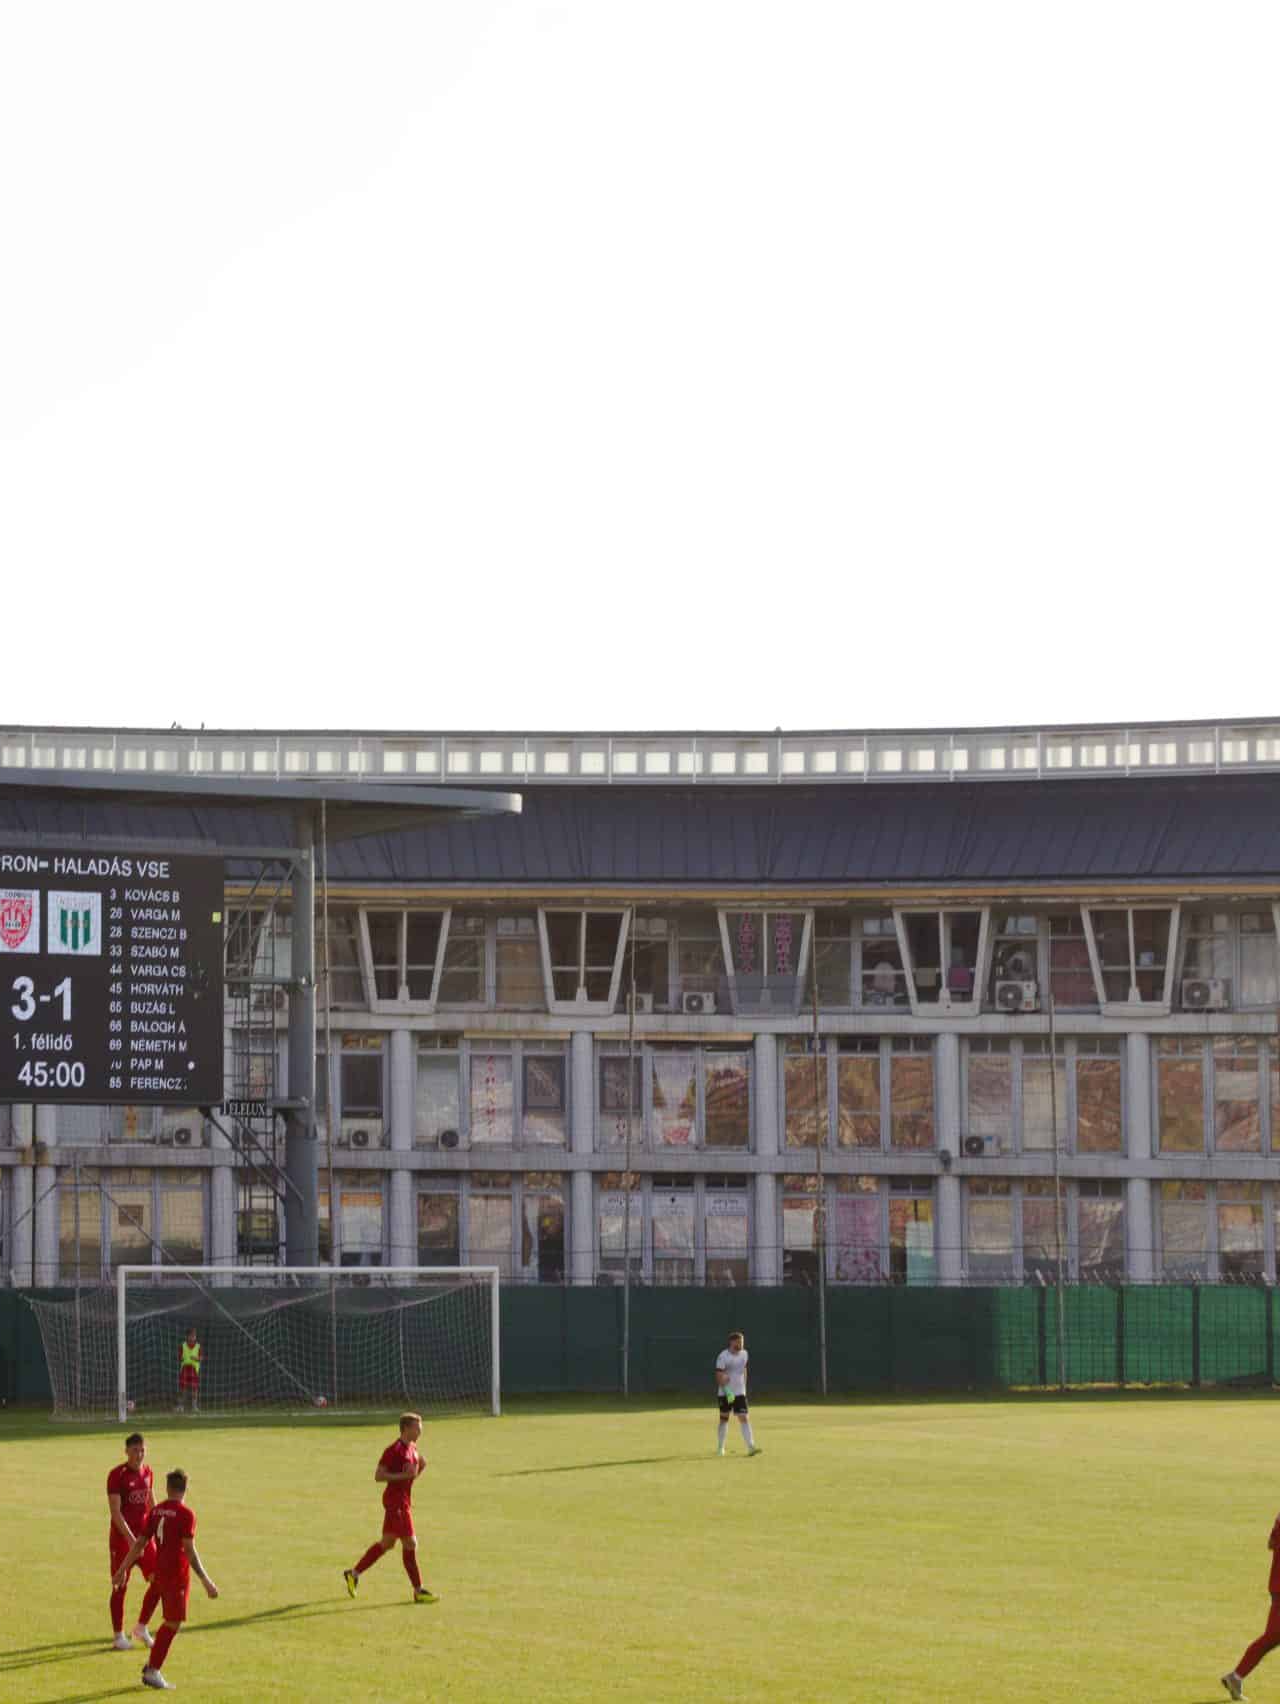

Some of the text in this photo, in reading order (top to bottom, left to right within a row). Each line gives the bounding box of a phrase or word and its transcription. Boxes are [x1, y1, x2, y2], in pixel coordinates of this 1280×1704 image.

[53, 856, 133, 877] HALADÁS
[135, 860, 170, 878] VSE
[109, 888, 180, 903] 3 KOVÁCS B
[130, 908, 169, 920] VARGA
[170, 909, 181, 921] M
[109, 926, 188, 941] 28 SZENCZI B
[109, 944, 180, 959] 33 SZABÓ M
[109, 964, 123, 976] 44
[130, 965, 169, 977] VARGA
[109, 982, 184, 995] 45 HORVÁTH
[11, 975, 72, 1021] 3-1
[130, 1000, 167, 1014] BUZÁS
[168, 1003, 176, 1014] L
[130, 1020, 176, 1033] BALOGH
[13, 1032, 73, 1052] 1. félidő
[130, 1038, 176, 1052] NÉMETH
[154, 1058, 164, 1070] M
[18, 1061, 85, 1089] 45:00
